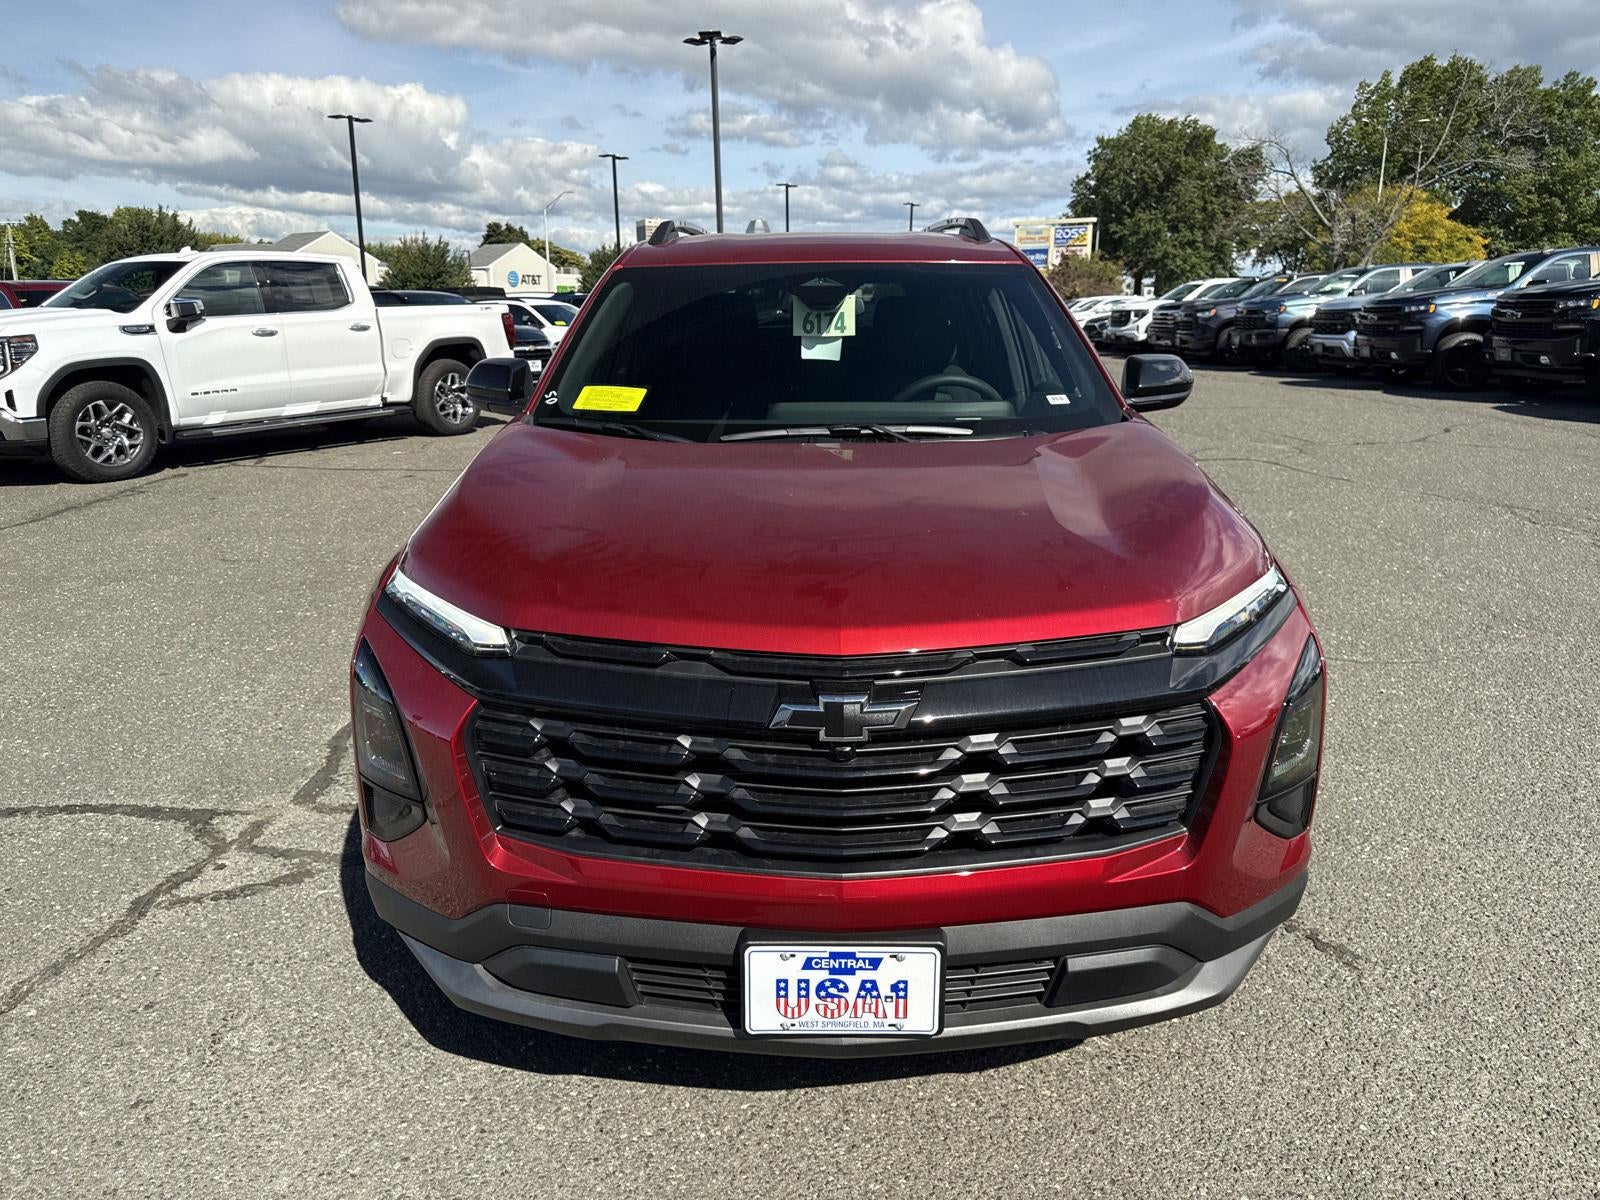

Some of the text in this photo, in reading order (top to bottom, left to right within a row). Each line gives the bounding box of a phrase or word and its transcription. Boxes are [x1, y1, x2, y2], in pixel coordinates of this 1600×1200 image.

[1055, 228, 1087, 239] ROSS
[520, 274, 542, 286] AT&T
[802, 311, 847, 335] 6174
[811, 958, 874, 969] CENTRAL
[775, 978, 908, 1019] USA-1
